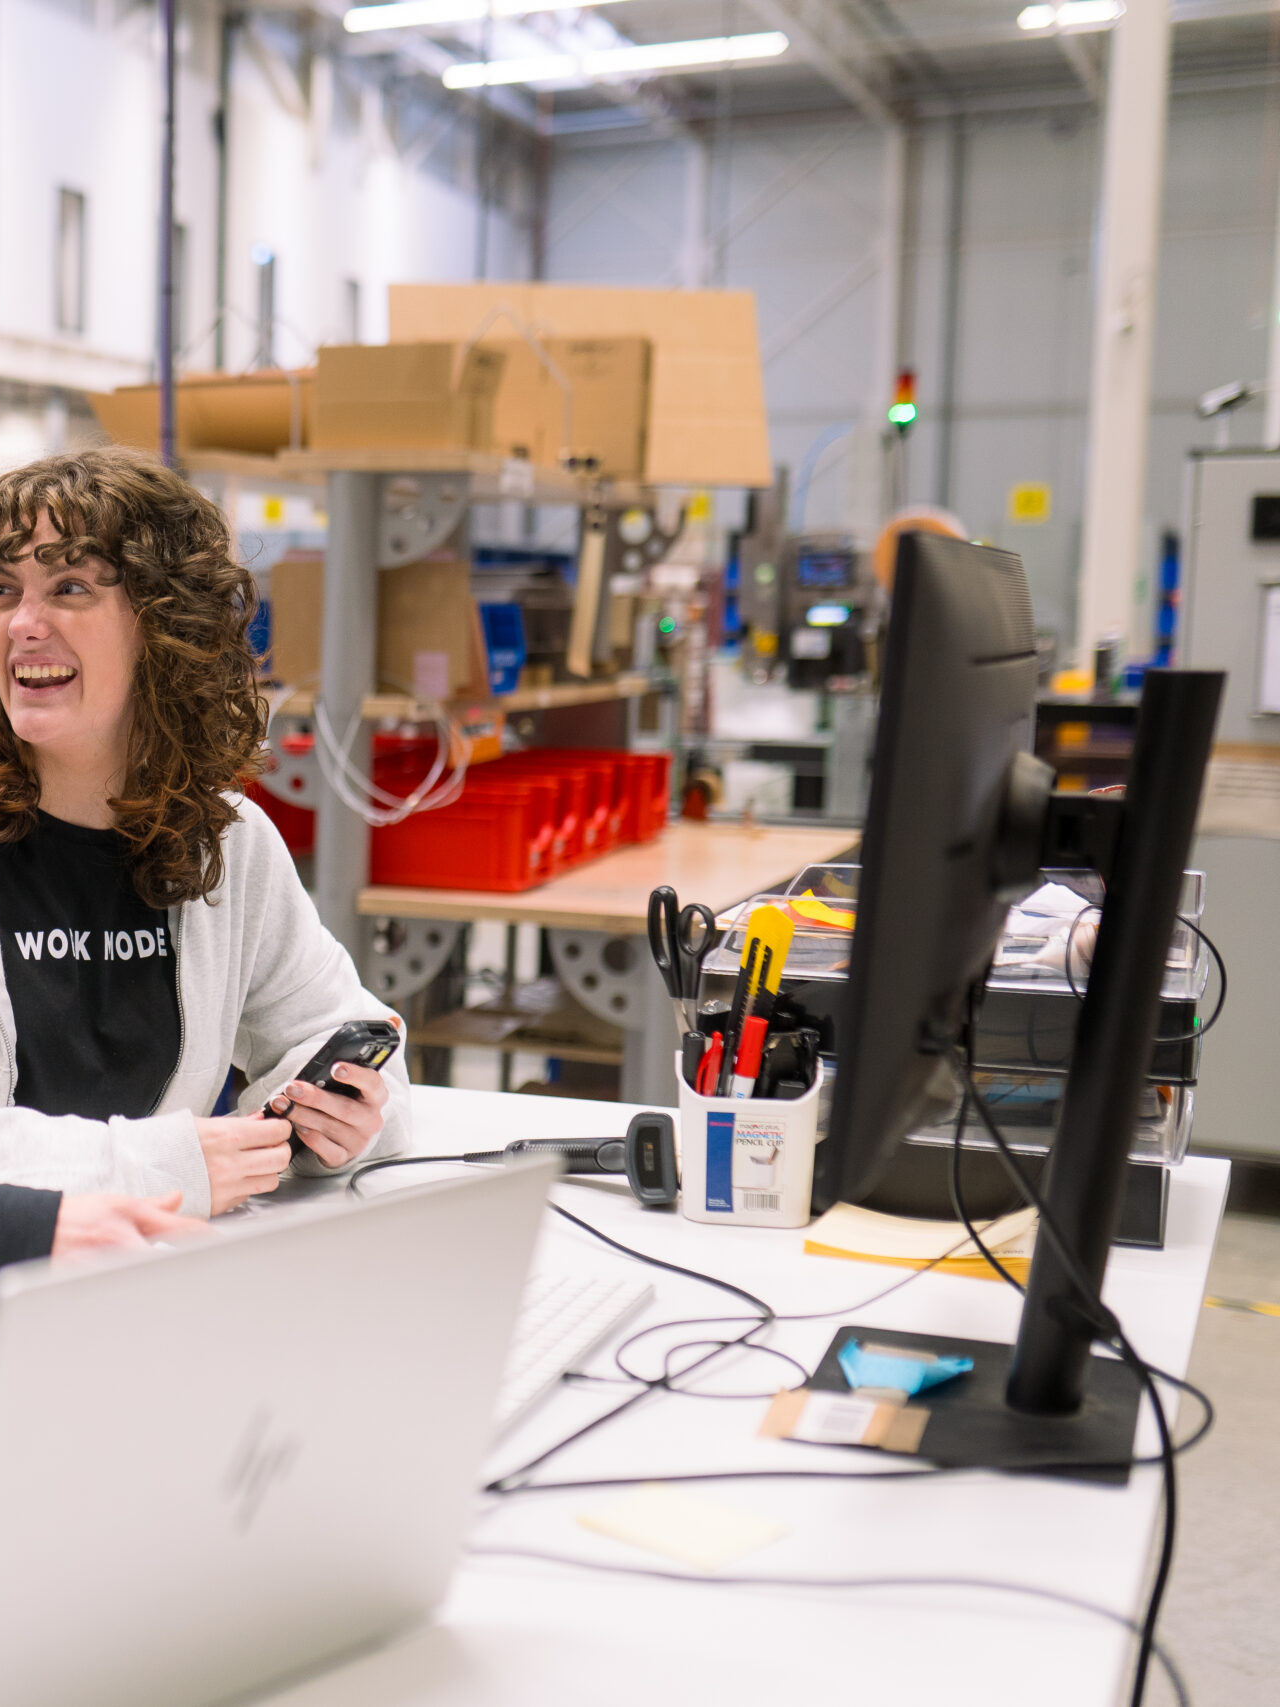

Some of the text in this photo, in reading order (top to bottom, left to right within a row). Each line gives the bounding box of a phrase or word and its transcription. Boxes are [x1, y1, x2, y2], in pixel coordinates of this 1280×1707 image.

[14, 927, 168, 960] WOK MODE
[736, 1130, 784, 1139] MAGNETIC
[736, 1138, 784, 1147] PENCIL CUP
